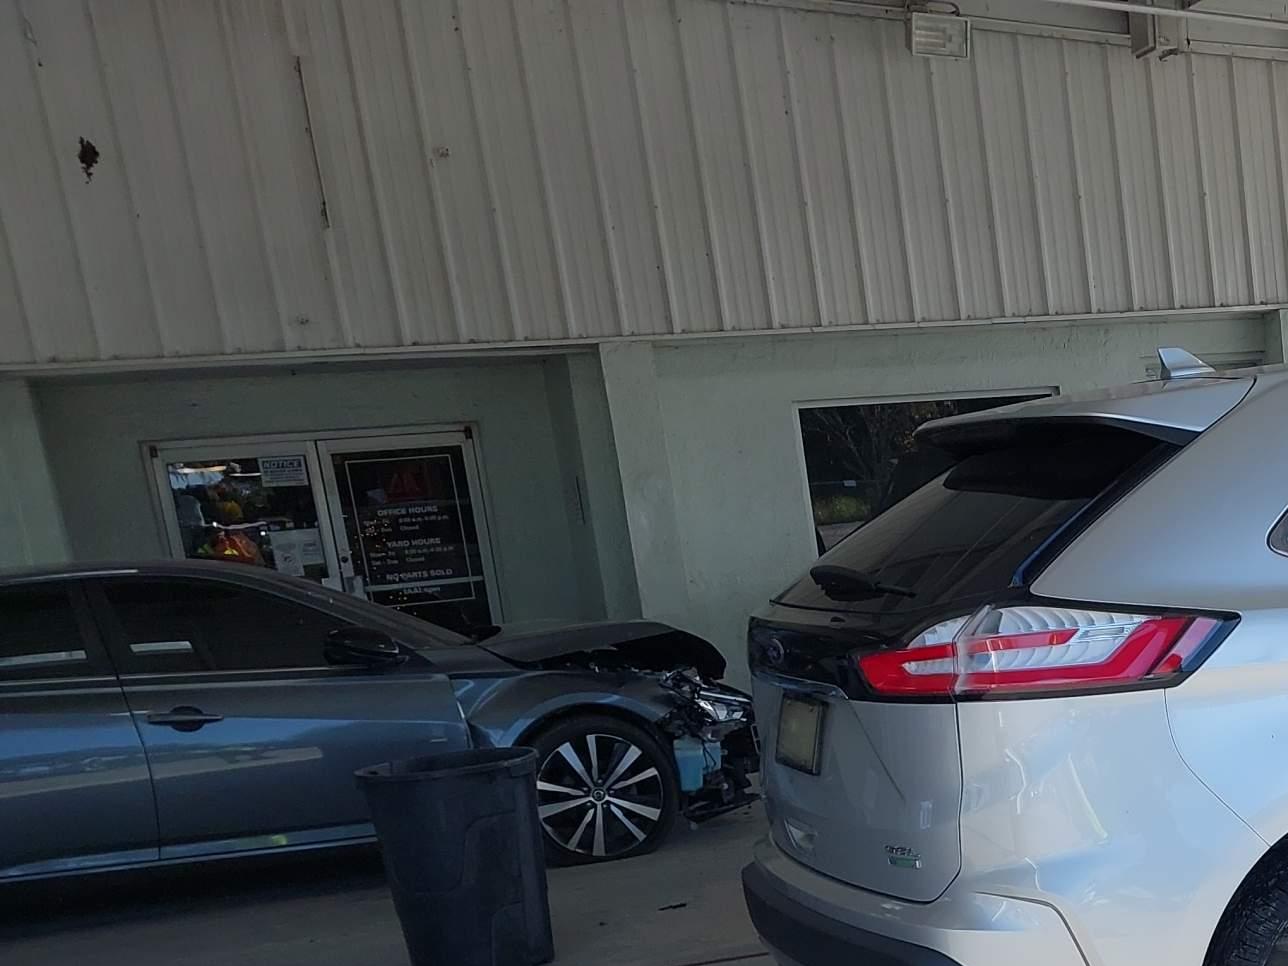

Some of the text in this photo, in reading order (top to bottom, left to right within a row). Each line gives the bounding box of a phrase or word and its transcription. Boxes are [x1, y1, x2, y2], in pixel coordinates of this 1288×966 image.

[263, 459, 301, 469] NOTICE
[377, 505, 438, 517] OFFICE HOURS
[385, 537, 441, 549] YARD HOURS
[401, 570, 429, 579] PARTS
[429, 568, 453, 577] SOLD
